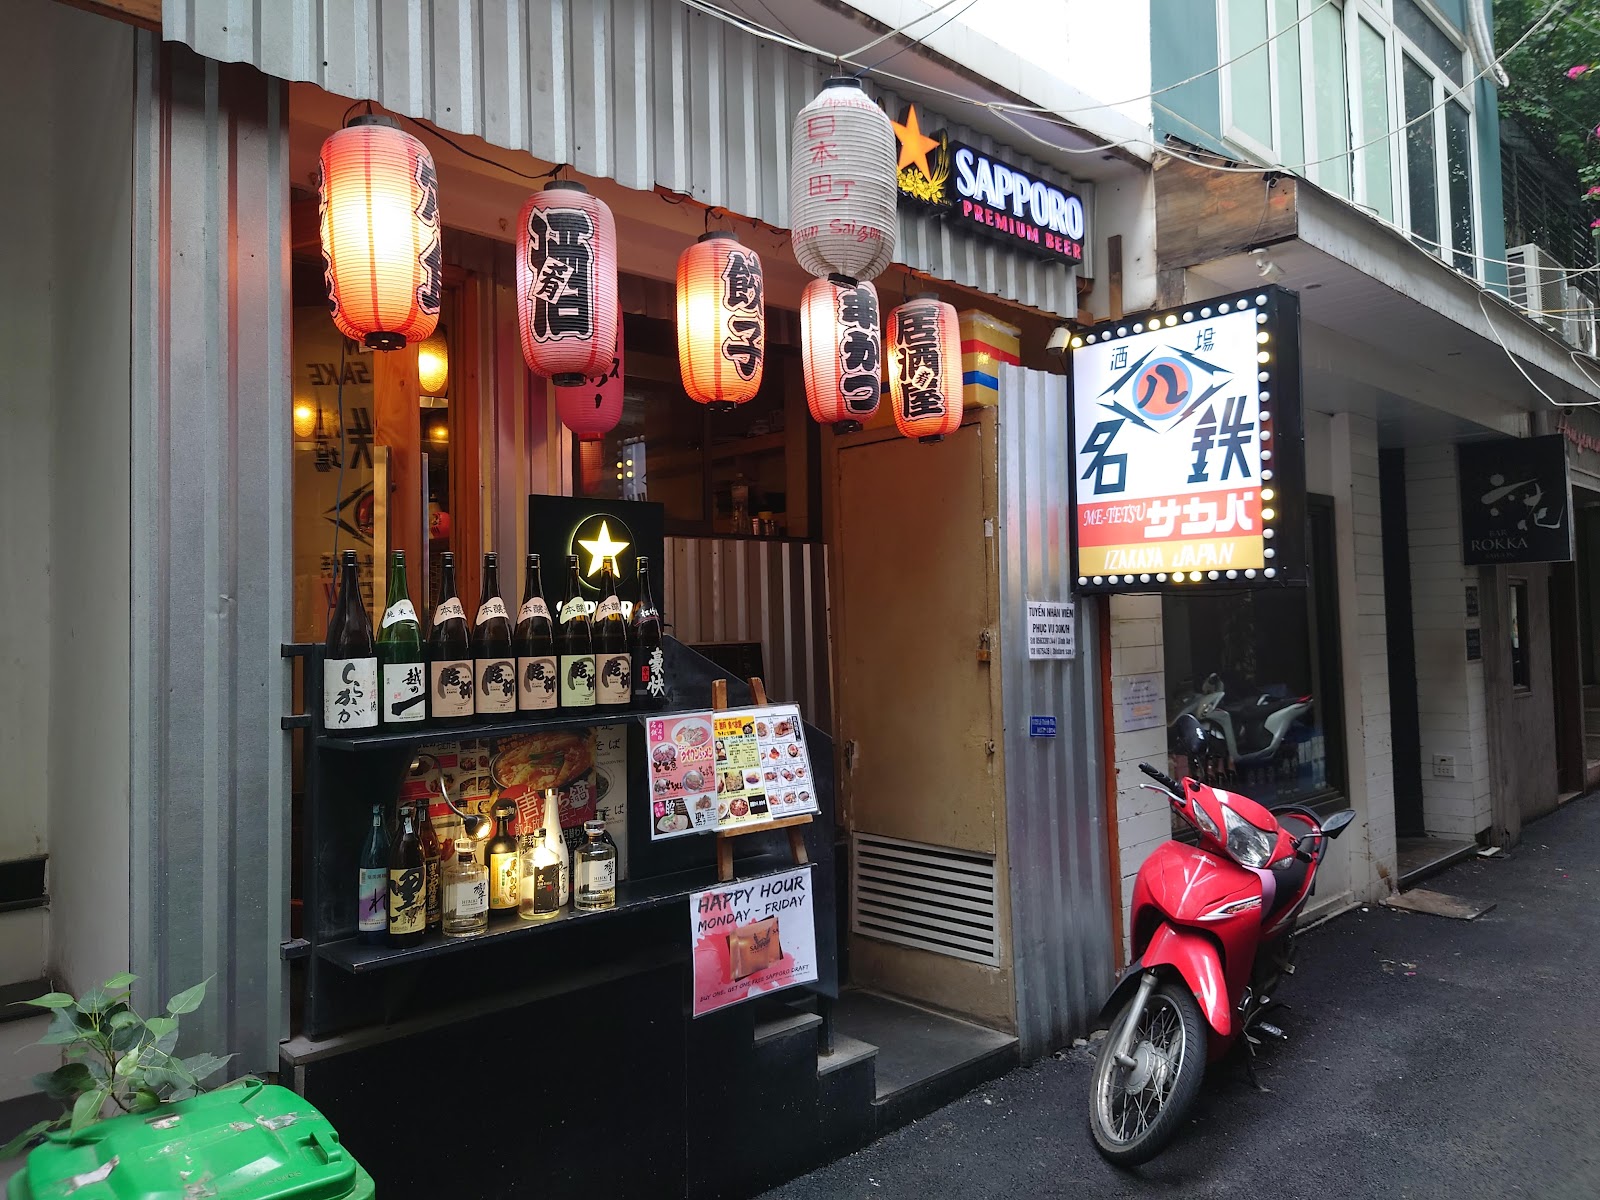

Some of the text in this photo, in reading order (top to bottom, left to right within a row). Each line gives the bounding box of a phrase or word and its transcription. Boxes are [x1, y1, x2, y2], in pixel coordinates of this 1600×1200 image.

[807, 115, 856, 202] 日本町
[955, 148, 1085, 241] SAPPORO
[962, 199, 1083, 260] PREMIUM BEER
[895, 303, 946, 422] 居酒屋
[1080, 395, 1255, 495] 名 鉄
[1083, 491, 1254, 539] ME-TETSU サカバ
[1103, 542, 1236, 570] IZAKAYA JAPAN
[1471, 537, 1529, 552] ROKKA
[440, 603, 465, 616] 本醸
[565, 602, 587, 615] 本醸
[601, 602, 622, 613] 本醸
[646, 647, 665, 697] 豪快
[697, 875, 806, 913] HAPPY HOUR
[697, 908, 751, 933] MONDAY
[764, 894, 806, 915] FRIDAY
[699, 993, 711, 1002] BUY
[727, 984, 739, 993] GET
[739, 981, 751, 989] ONE
[765, 967, 790, 981] SAPPORO
[791, 964, 810, 974] DRAFT
